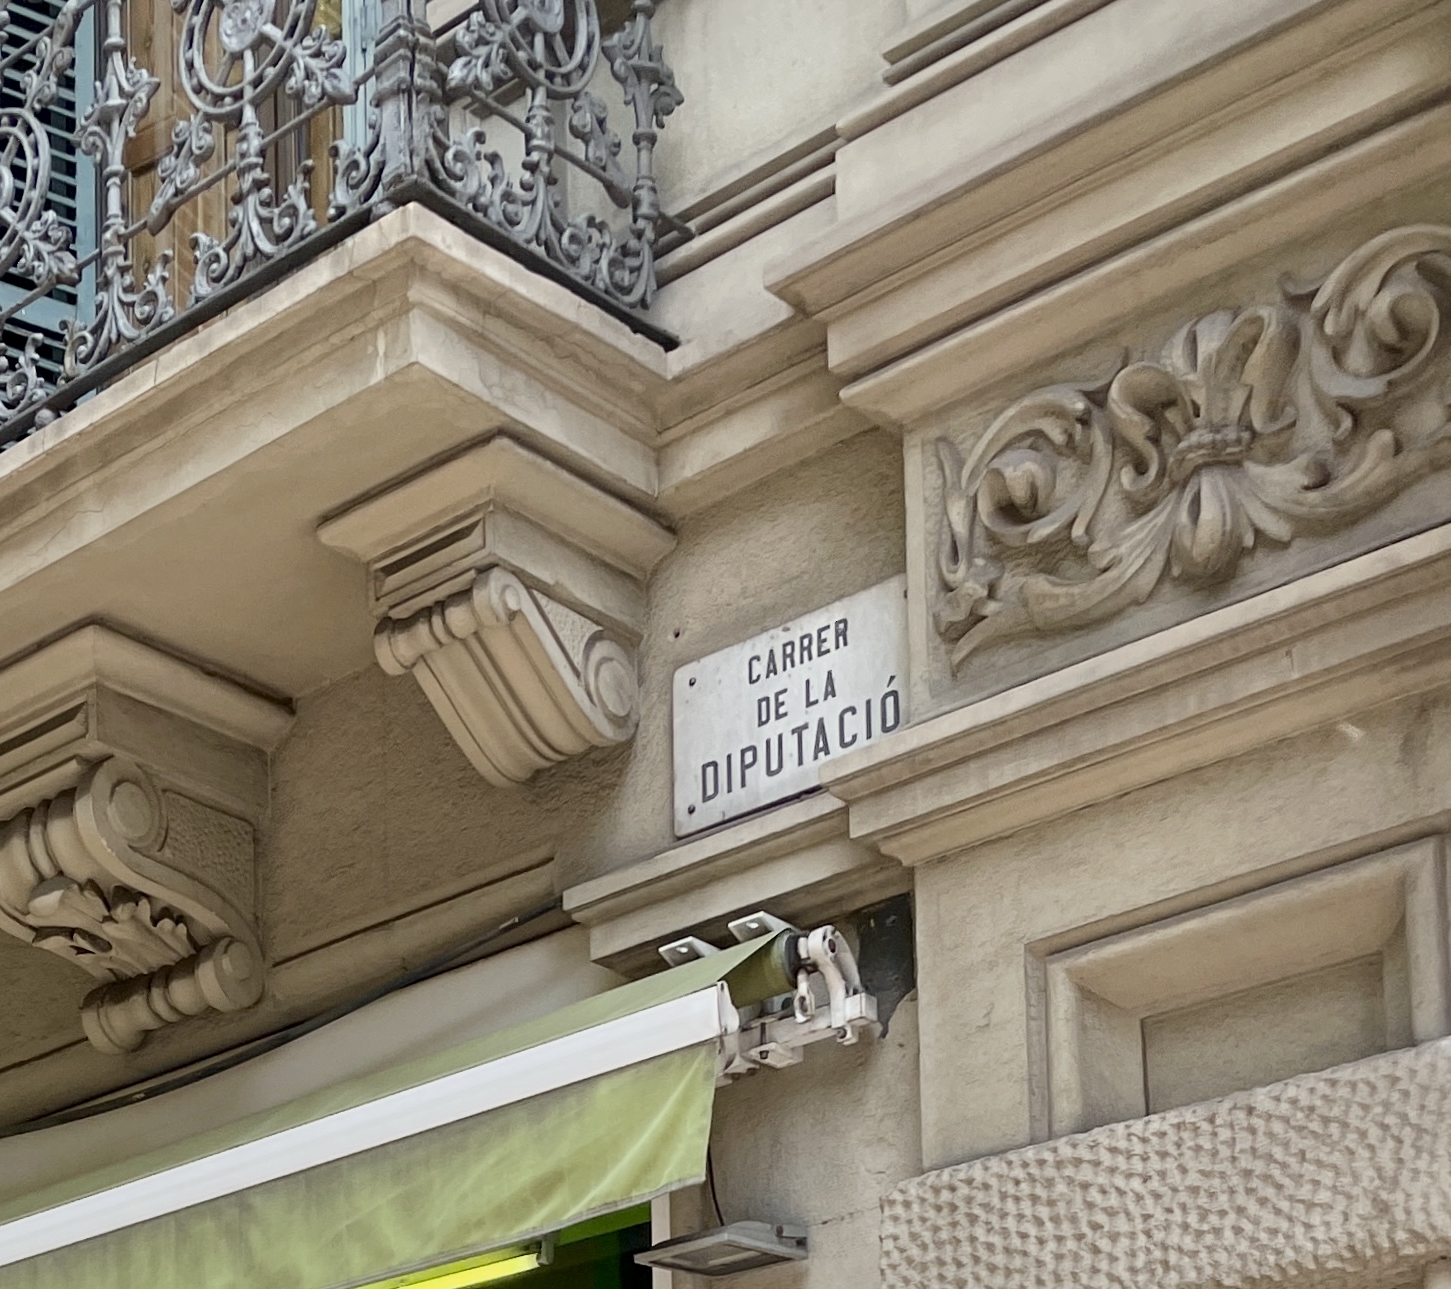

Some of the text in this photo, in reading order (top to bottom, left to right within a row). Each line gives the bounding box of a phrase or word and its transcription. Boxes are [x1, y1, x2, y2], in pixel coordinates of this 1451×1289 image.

[748, 617, 849, 686] CARRER
[757, 669, 837, 728] DE LA
[701, 674, 901, 804] DIPUTACIÓ
